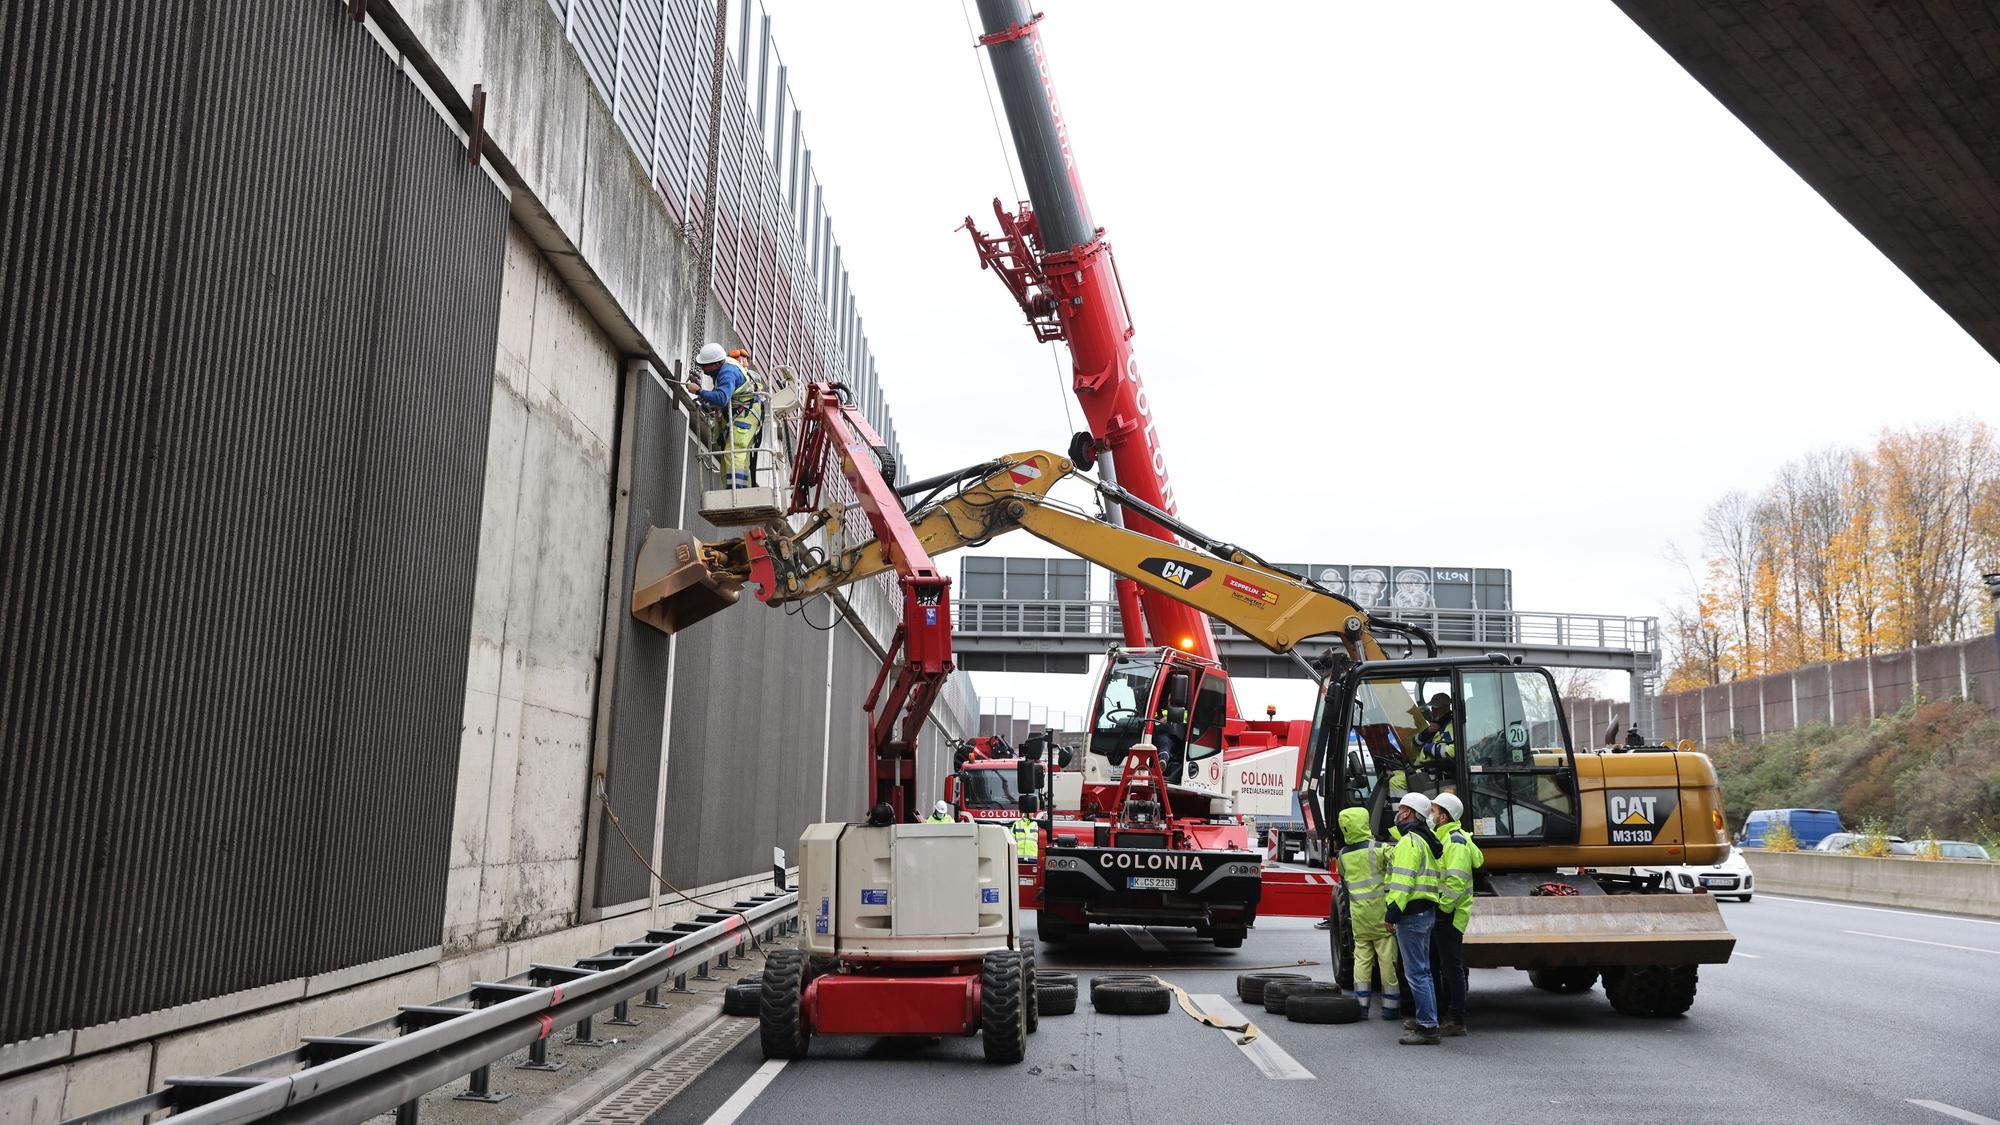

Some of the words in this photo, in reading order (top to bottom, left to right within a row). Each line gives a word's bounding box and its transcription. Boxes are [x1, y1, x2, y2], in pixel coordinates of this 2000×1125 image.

[1033, 38, 1074, 170] COLONIA
[1161, 561, 1194, 587] CAT
[1436, 571, 1469, 583] KLON
[1229, 580, 1260, 595] ZEPPELIN
[1510, 728, 1524, 743] 20
[1241, 771, 1284, 787] COLONIA
[1241, 787, 1284, 796] SPEZIALFAHRZEUGE
[1610, 796, 1657, 825] CAT
[1613, 830, 1653, 842] M313D
[1100, 853, 1203, 871] COLONIA
